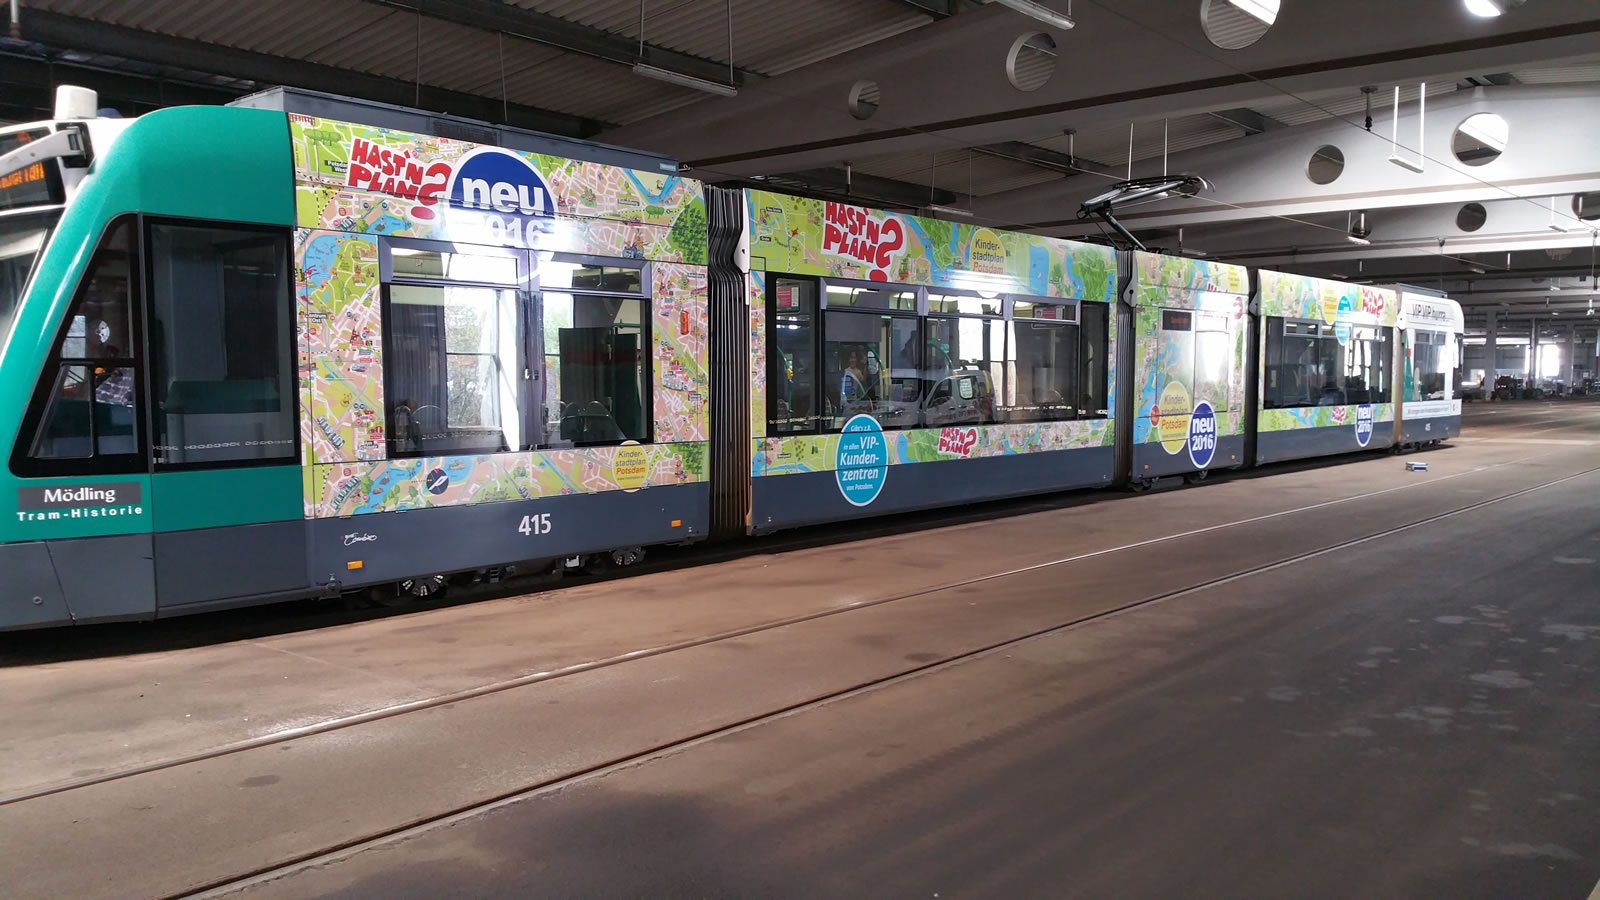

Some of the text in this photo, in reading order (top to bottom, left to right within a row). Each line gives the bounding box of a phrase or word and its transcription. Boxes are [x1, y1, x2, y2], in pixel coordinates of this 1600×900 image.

[462, 177, 545, 217] neu
[975, 239, 1000, 251] Kinder-
[972, 251, 1004, 263] stadtplan
[1192, 417, 1214, 434] neu
[860, 436, 880, 450] VIP-
[1192, 434, 1214, 452] 2016
[618, 450, 643, 459] Kinder-
[840, 450, 880, 466] Kunden-
[615, 458, 646, 468] stadtplan
[615, 466, 646, 476] Potsdam
[842, 468, 879, 482] zentren
[43, 487, 116, 503] Mödling
[16, 505, 143, 522] Tram-Historie
[518, 513, 552, 536] 415
